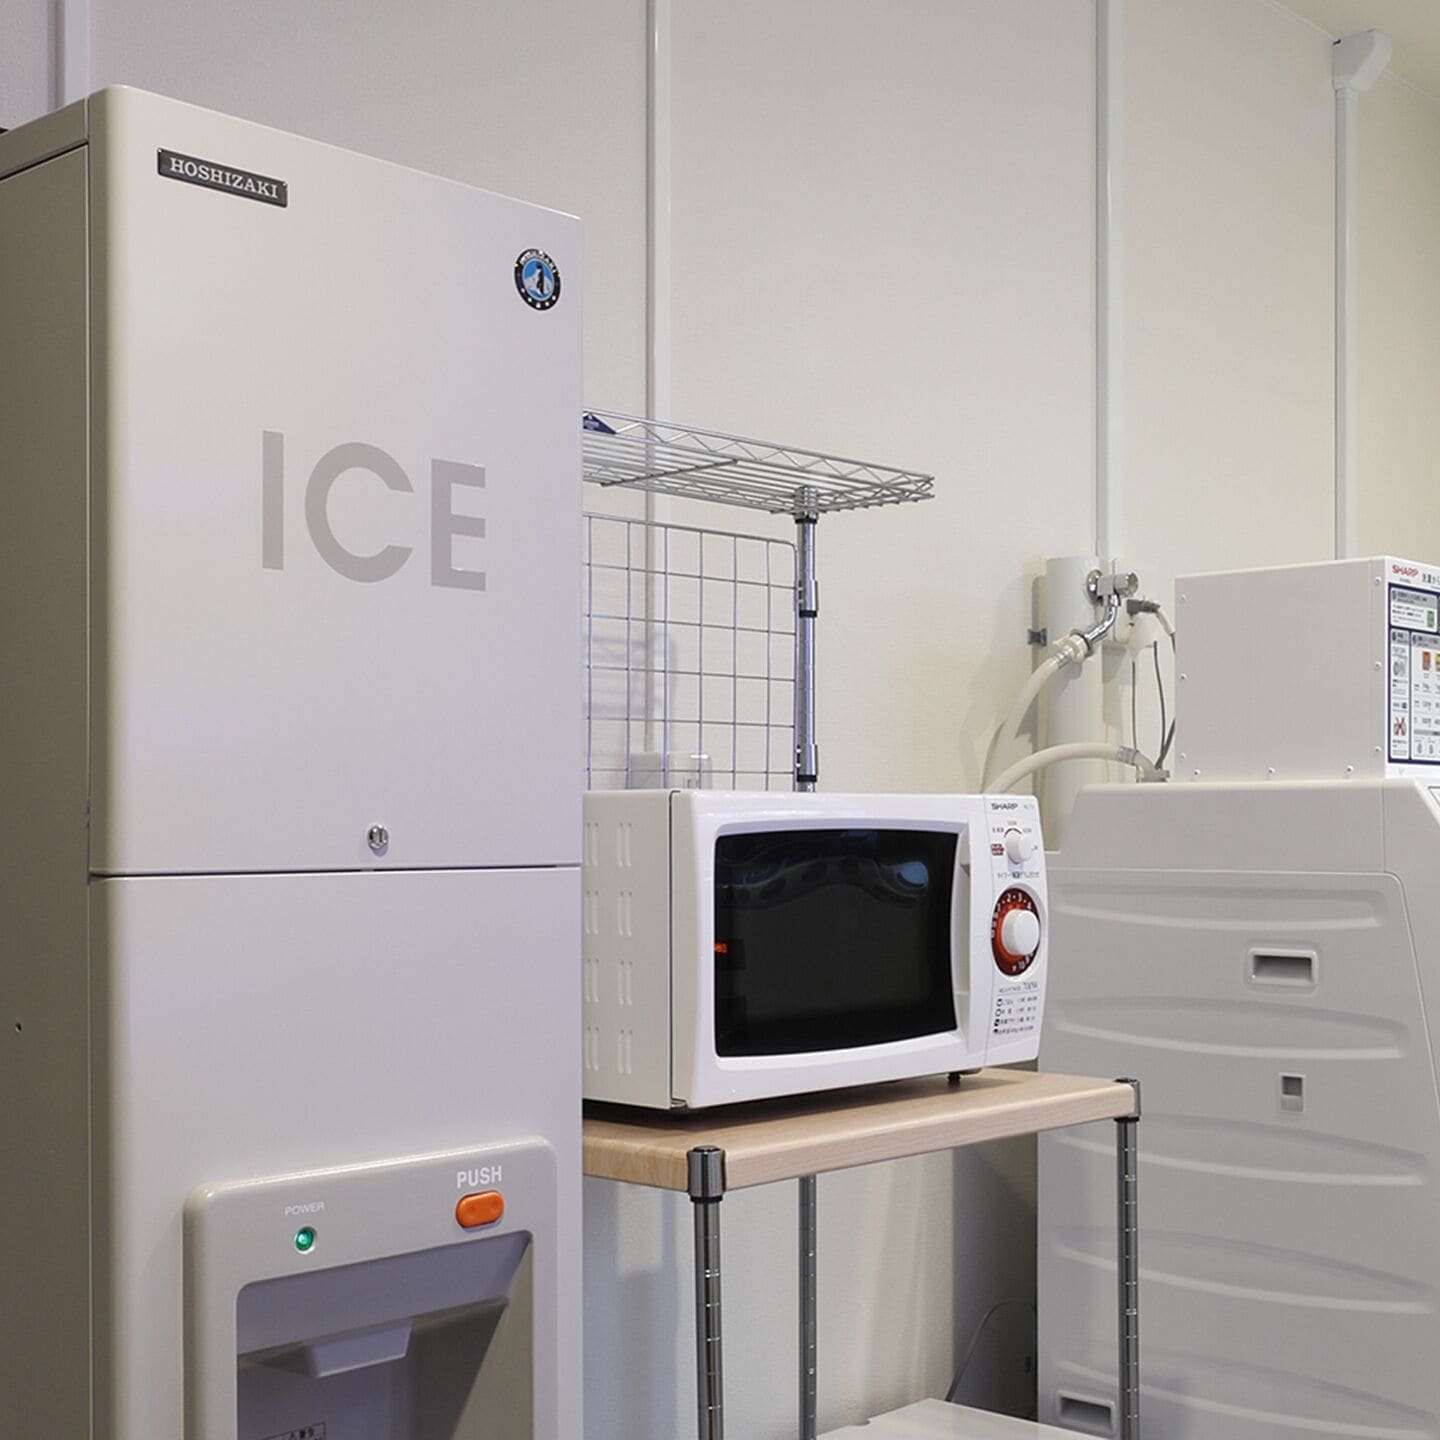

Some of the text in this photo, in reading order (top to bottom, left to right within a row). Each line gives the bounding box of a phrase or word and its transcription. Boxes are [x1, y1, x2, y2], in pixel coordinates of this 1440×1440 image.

[170, 157, 279, 199] HOSHIZAKI
[262, 430, 487, 592] ICE
[1391, 564, 1420, 577] SHARP
[990, 802, 1018, 811] SHARP
[456, 1165, 502, 1189] PUSH
[284, 1201, 325, 1216] POWER
